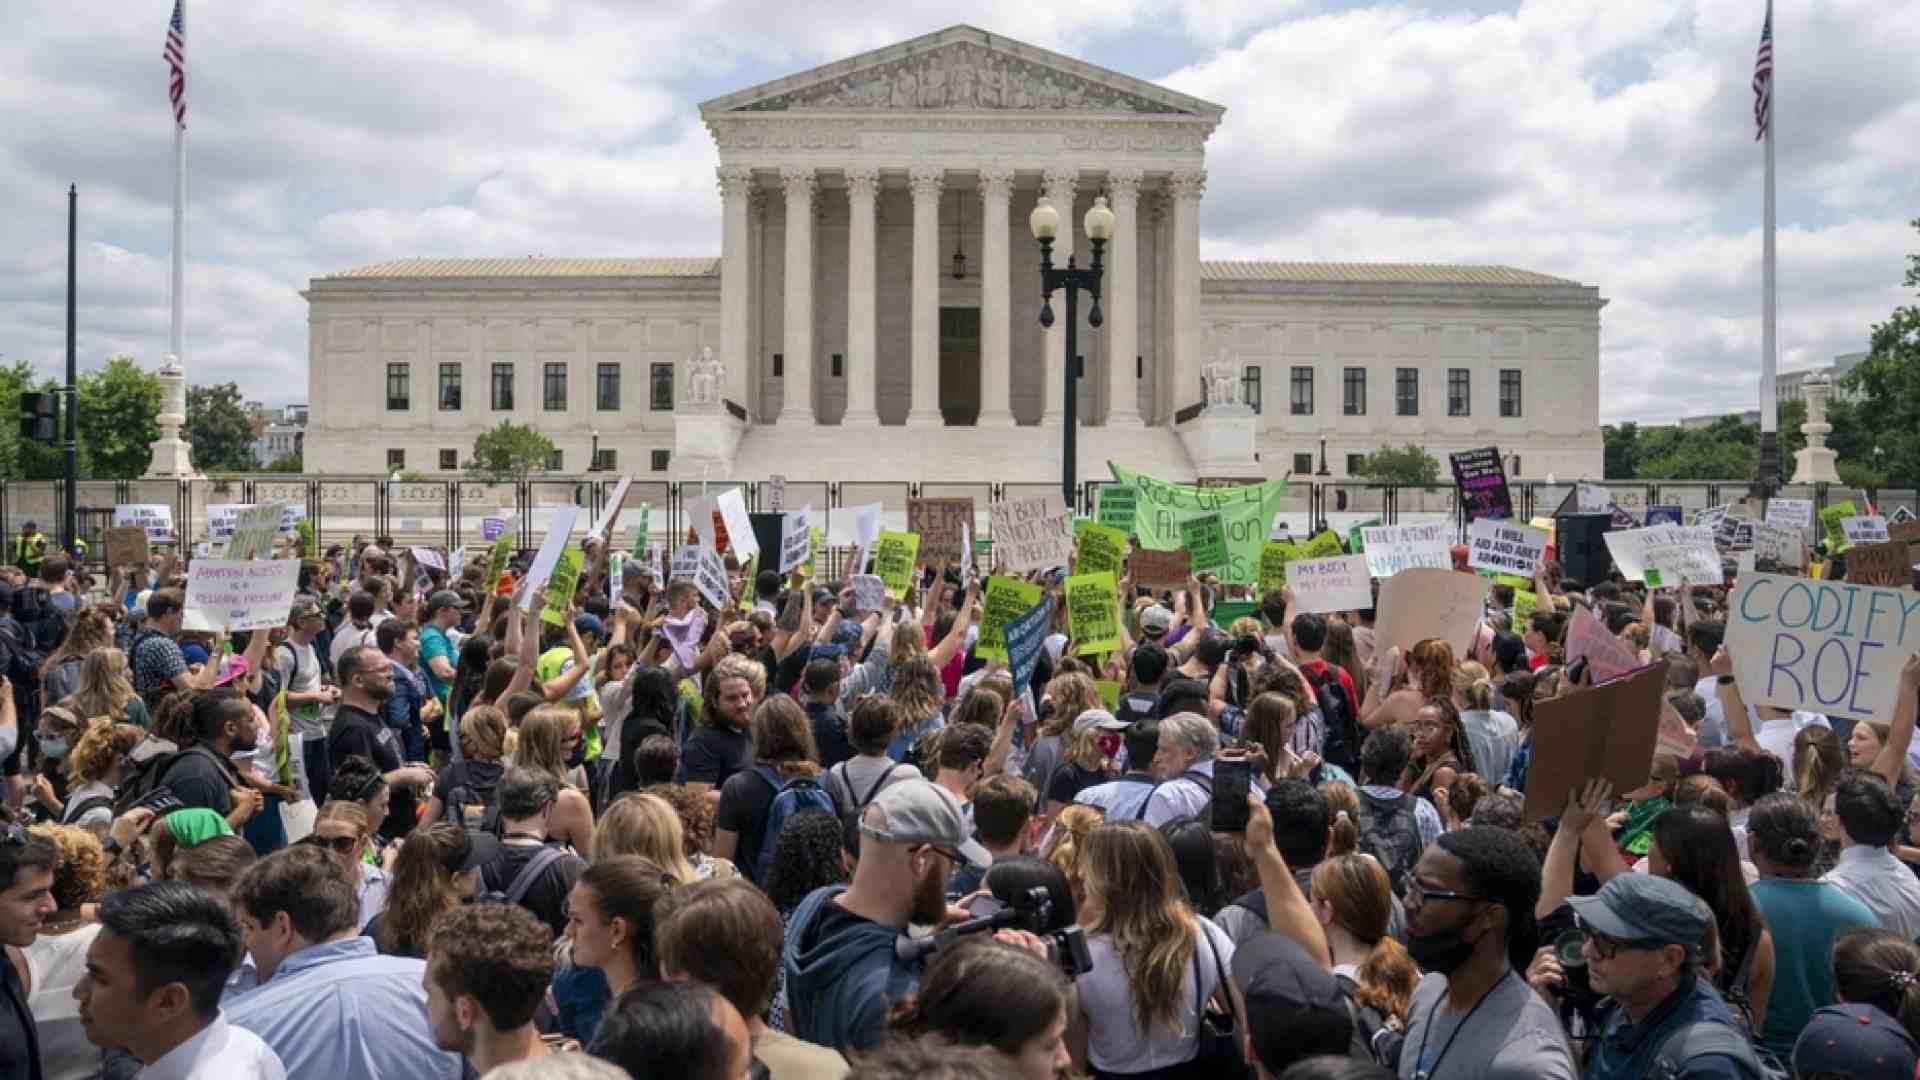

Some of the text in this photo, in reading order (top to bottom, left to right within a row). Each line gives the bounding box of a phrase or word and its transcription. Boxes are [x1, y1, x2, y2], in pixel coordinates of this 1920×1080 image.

[1502, 529, 1524, 543] WILL
[1475, 538, 1491, 550] AID
[1493, 541, 1513, 554] AND
[1477, 552, 1534, 571] ABORTION
[1740, 579, 1920, 647] CODIFY
[1767, 632, 1885, 715] ROE
